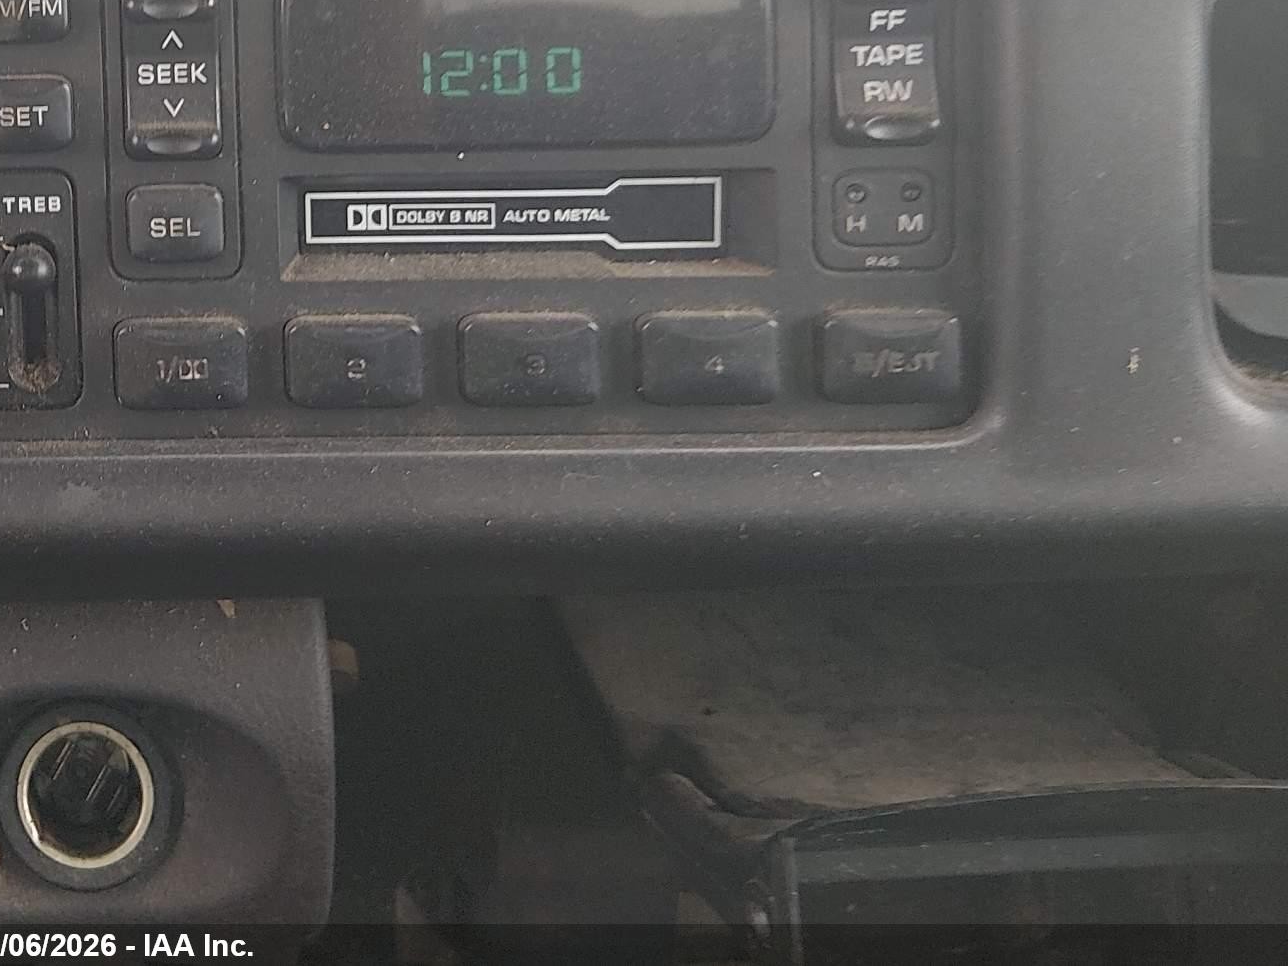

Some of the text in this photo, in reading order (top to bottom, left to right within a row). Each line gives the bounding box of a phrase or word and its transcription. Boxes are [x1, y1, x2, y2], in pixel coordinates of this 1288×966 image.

[869, 9, 906, 30] FF
[849, 42, 924, 67] TAPE
[137, 63, 207, 85] SEEK
[422, 47, 582, 96] 12:00
[863, 79, 913, 103] RW
[0, 106, 50, 127] SET
[2, 197, 62, 214] TREB
[395, 210, 444, 224] DOLBY
[464, 209, 489, 223] NR
[502, 209, 550, 223] AUTO
[554, 208, 611, 222] METAL
[150, 217, 201, 237] SEL
[846, 213, 923, 233] H M
[347, 358, 366, 379] 2
[704, 354, 725, 374] 4
